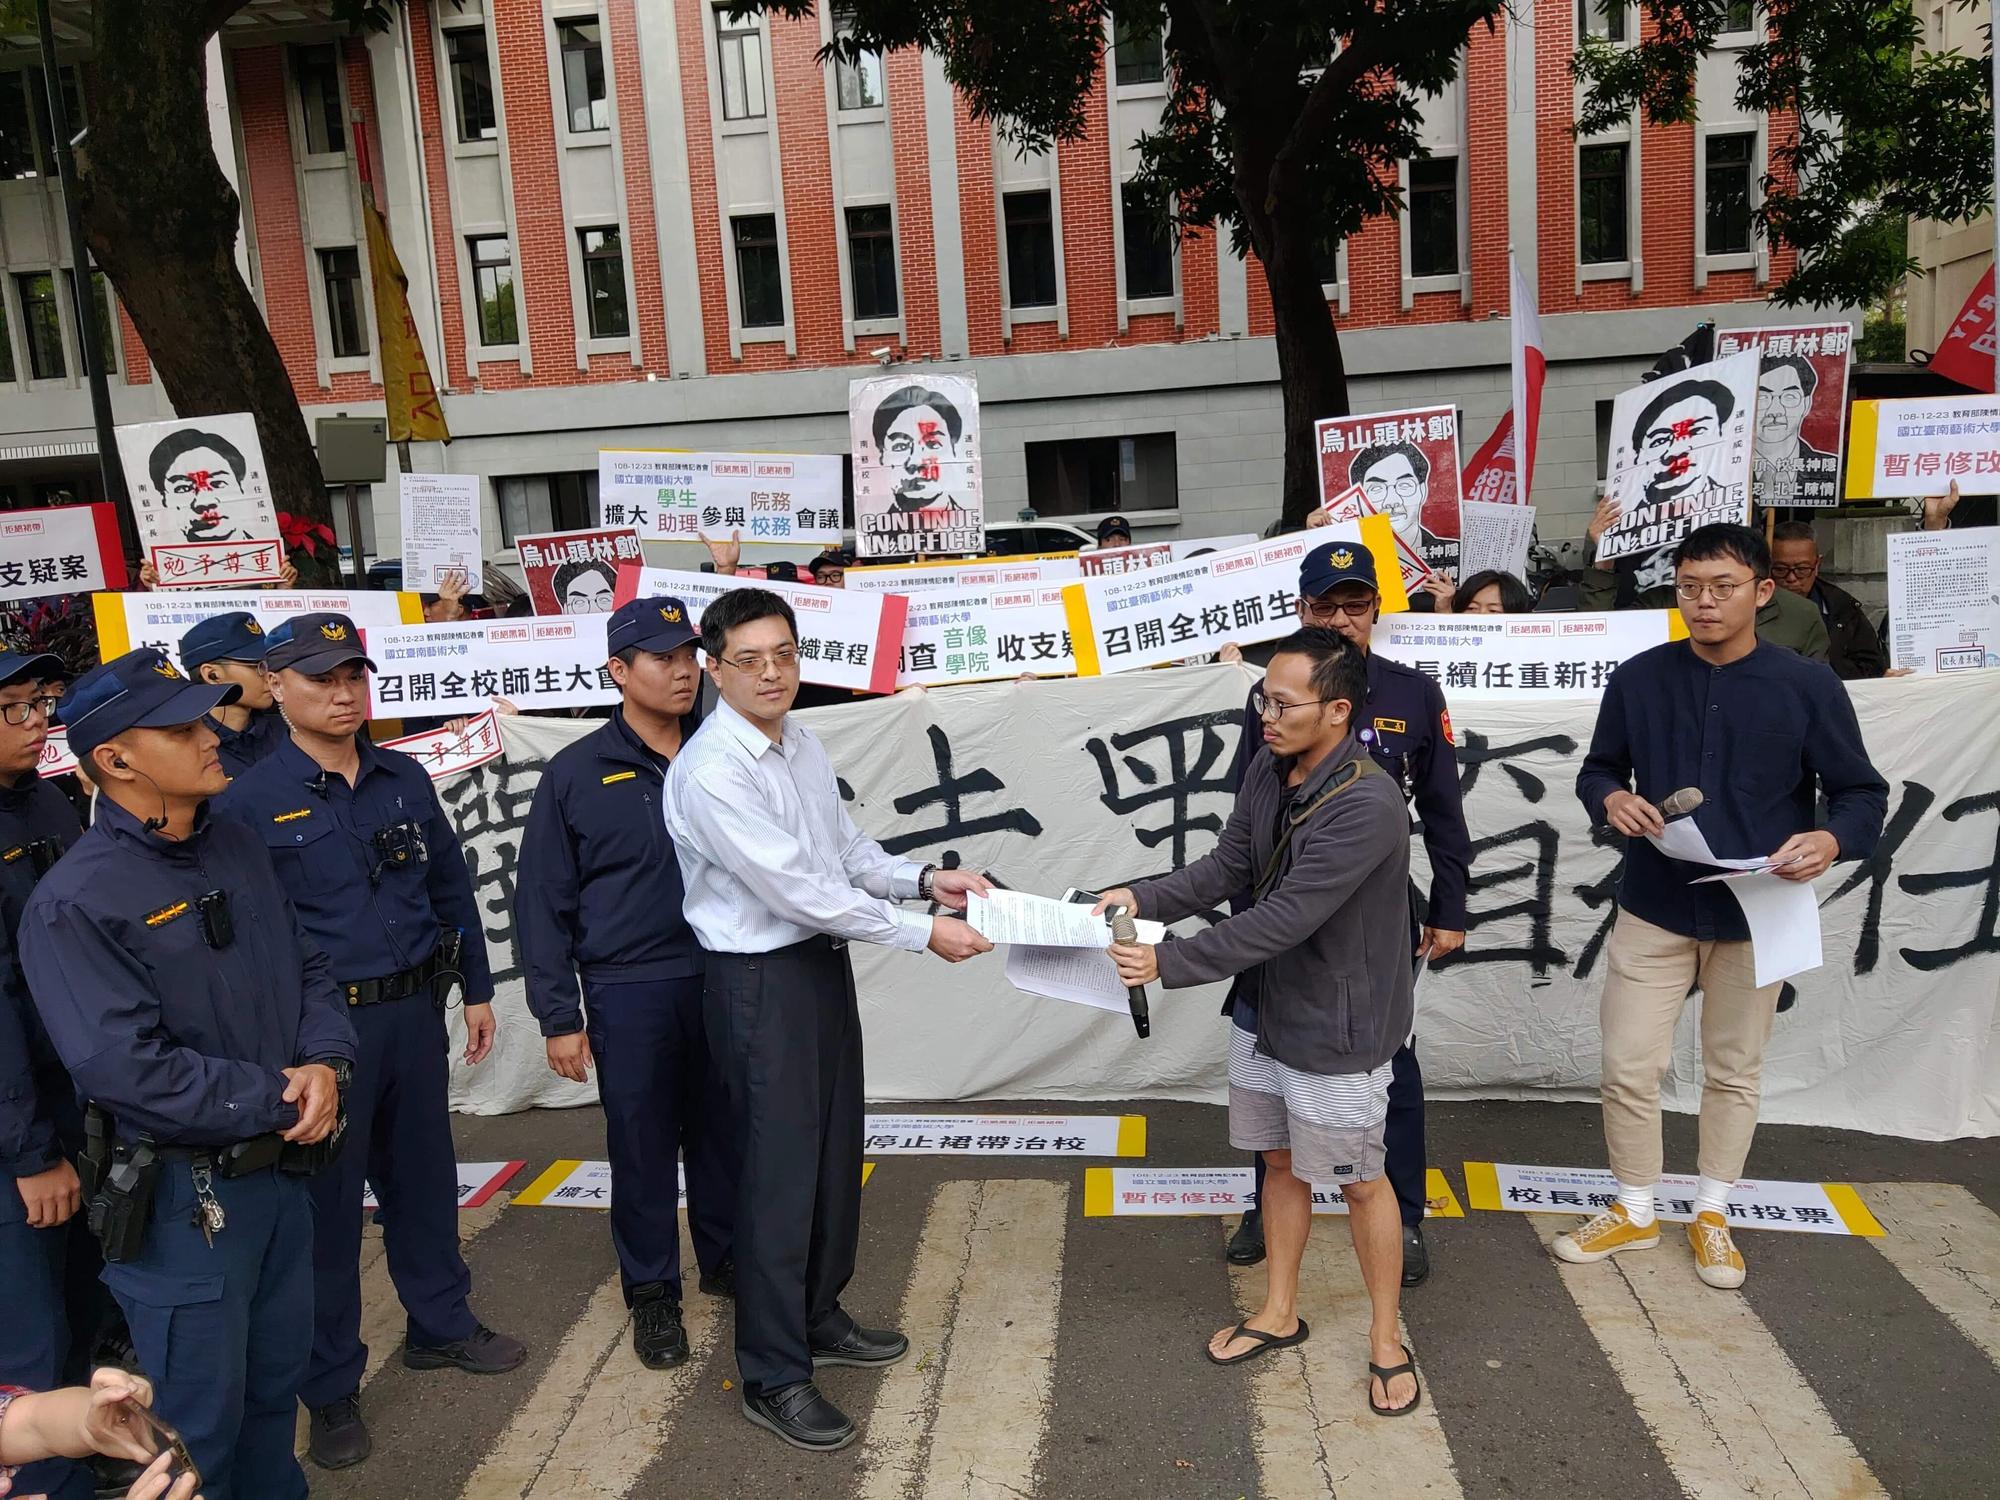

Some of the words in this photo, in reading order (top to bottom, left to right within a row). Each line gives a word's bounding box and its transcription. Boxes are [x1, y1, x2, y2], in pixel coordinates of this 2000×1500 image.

[1897, 411, 1950, 421] 108-12-23
[1321, 415, 1454, 454] 烏山頭林鄭
[1883, 451, 2000, 478] 暫停修改
[614, 474, 694, 485] 國立臺南藝術大學
[657, 488, 698, 508] 學生
[750, 491, 792, 512] 院務
[605, 504, 648, 525] 擴大
[702, 506, 746, 528] 參與
[795, 508, 840, 530] 會議
[1605, 482, 1744, 537] CONTINUE
[658, 513, 698, 533] 助理
[751, 516, 792, 536] 校務
[860, 509, 980, 533] CONTINUE
[522, 535, 640, 568] 烏山頭林鄭
[864, 534, 889, 556] IN
[896, 531, 980, 553] OFFICE
[1602, 532, 1630, 557] IN
[0, 555, 88, 588] 支疑案
[1104, 581, 1147, 596] 108-12-23
[1215, 557, 1254, 572] 拒絕黑箱
[654, 580, 690, 591] 108-12-23
[859, 580, 899, 588] 108-12-23
[145, 602, 192, 610] 108-12-23
[1107, 583, 1194, 612] 國立臺南藝術大學
[904, 611, 971, 628] 臺南藝術大學
[1102, 590, 1297, 657] 召開全校師生
[1510, 624, 1552, 634] 拒絕黑箱
[383, 635, 425, 644] 108-12-23
[943, 625, 987, 648] 音像
[1389, 635, 1484, 647] 國立臺南藝術大學
[384, 645, 469, 660] 國立臺南藝術大學
[945, 651, 990, 675] 學院
[1394, 660, 1620, 689] 長續任重新投
[864, 1135, 1087, 1151] 停止裙帶治校
[1122, 1192, 1236, 1205] 暫停修改
